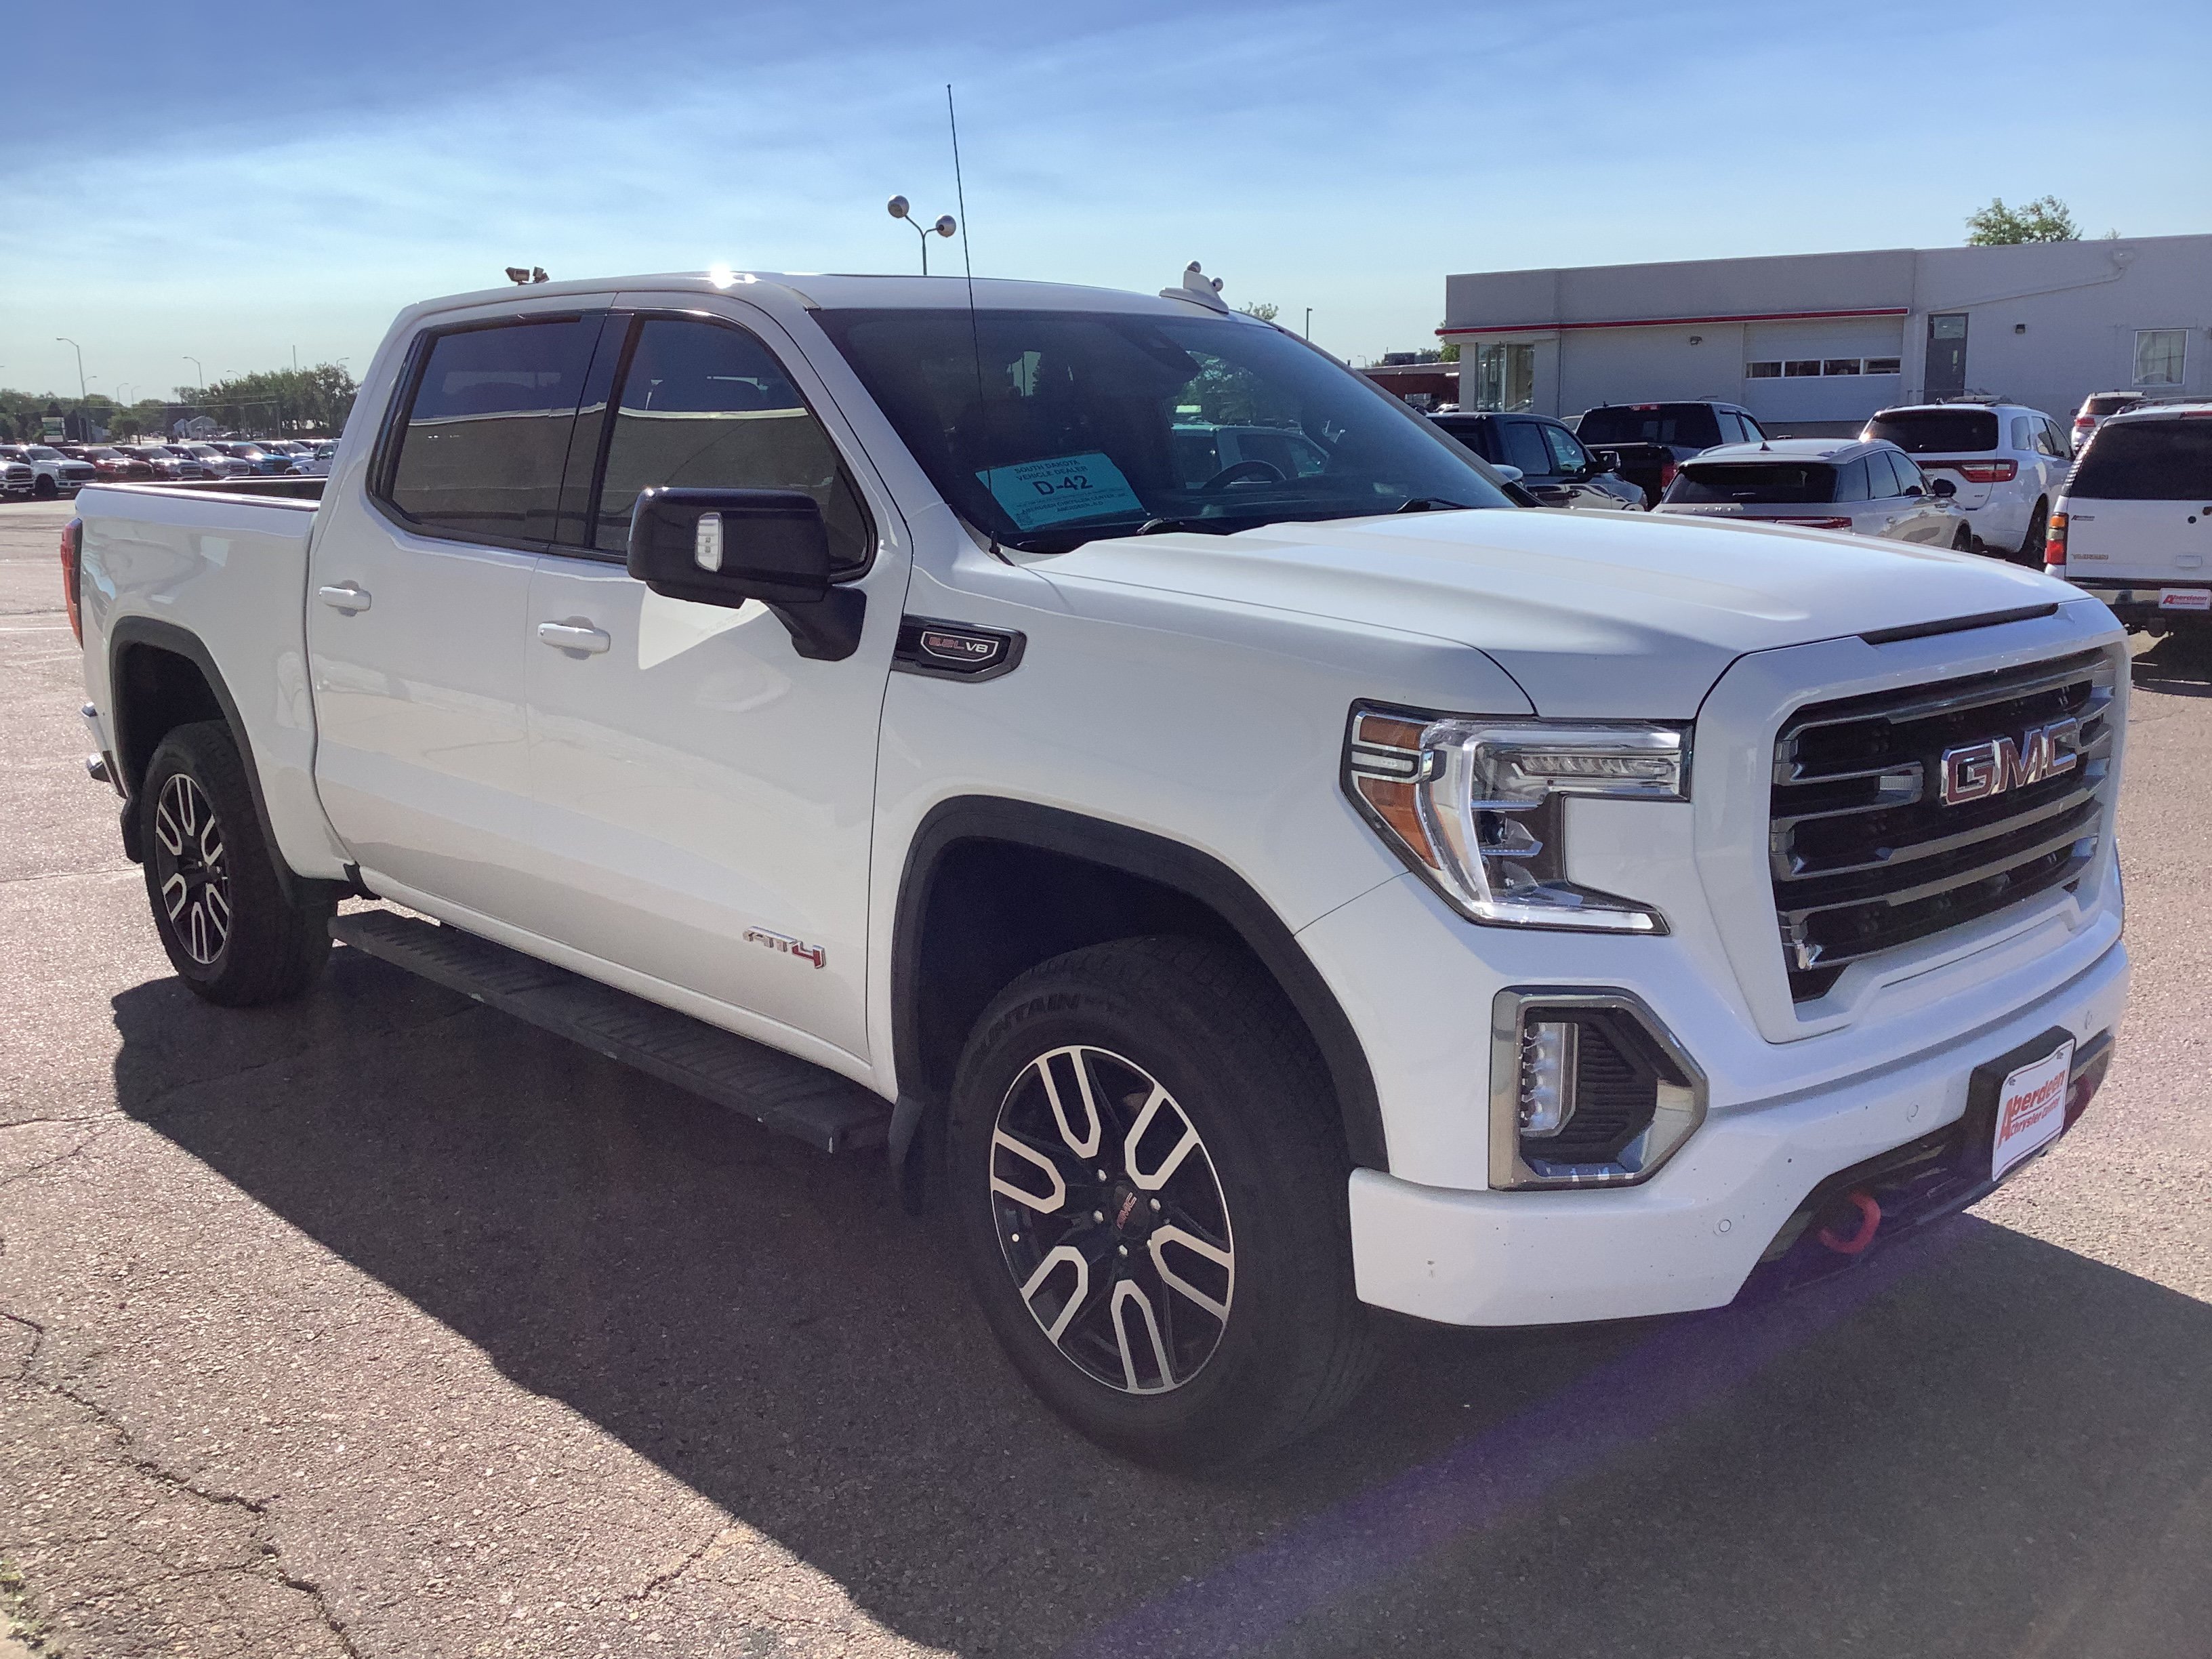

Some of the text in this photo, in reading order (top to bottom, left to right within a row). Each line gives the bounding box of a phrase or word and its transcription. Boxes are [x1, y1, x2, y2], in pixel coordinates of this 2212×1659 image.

[1014, 459, 1081, 474] SOUTH DAKOTA
[1016, 465, 1088, 481] VEHICLE DEALER
[1032, 475, 1093, 495] D-42
[966, 642, 989, 653] V8
[1940, 717, 2078, 806] GMC
[743, 926, 826, 969] AT4
[1996, 1070, 2066, 1149] Aberdeen
[2010, 1112, 2042, 1137] Chrysler
[1116, 1191, 1138, 1230] GMC
